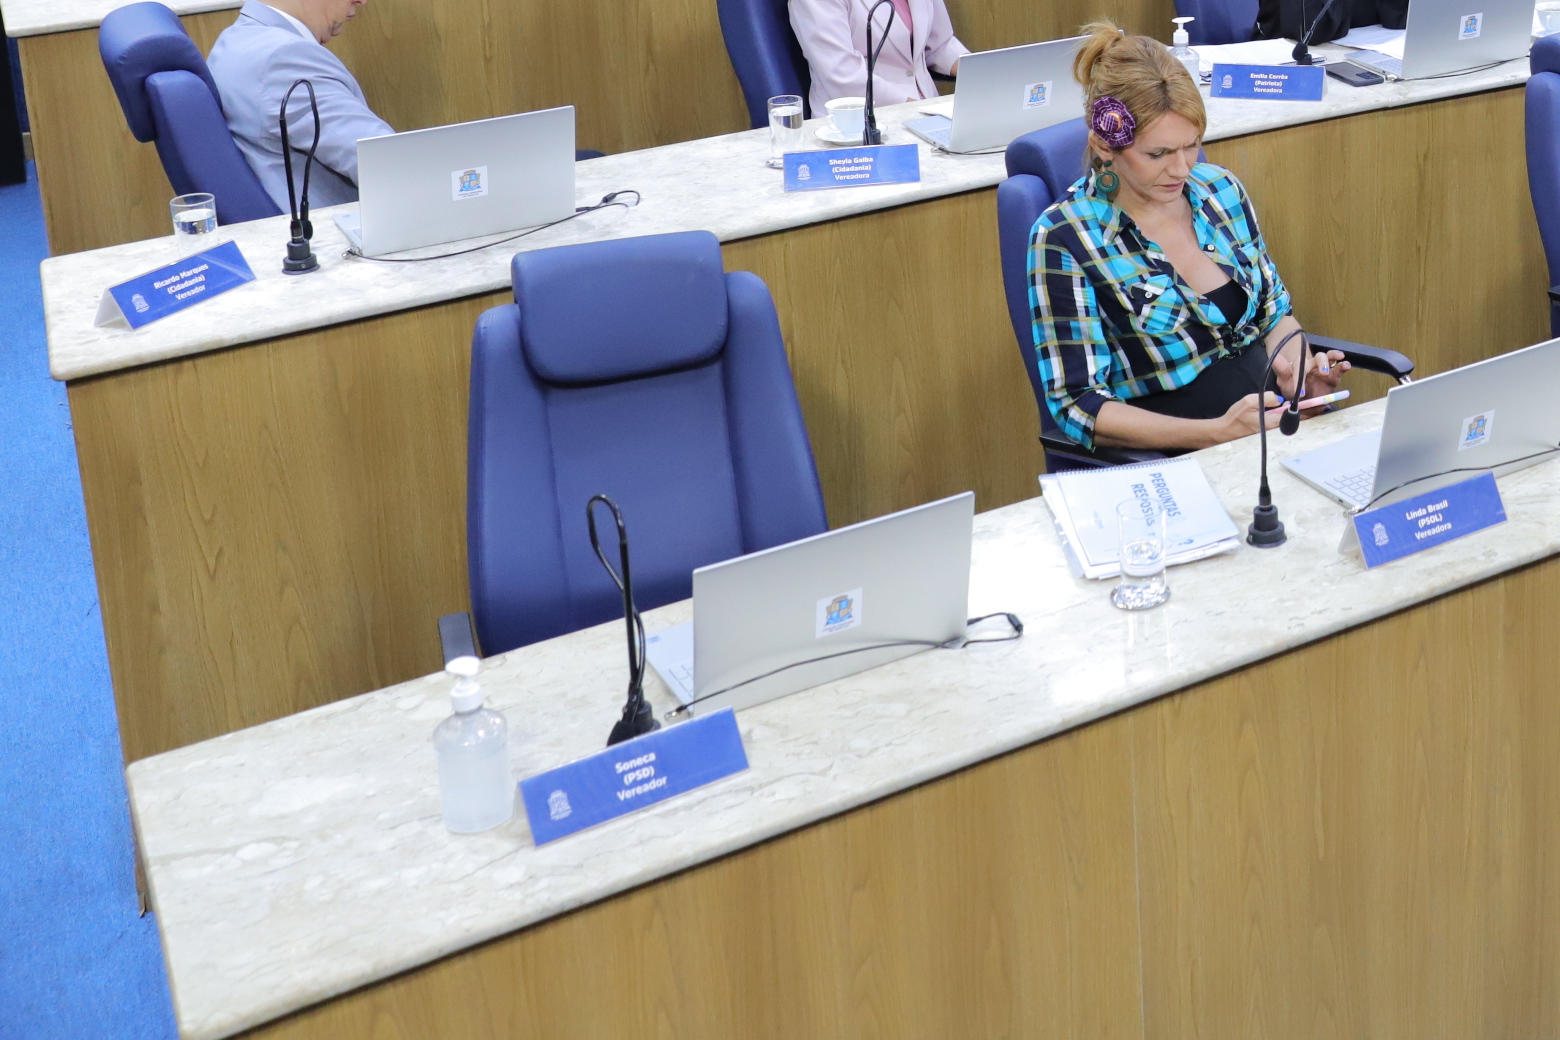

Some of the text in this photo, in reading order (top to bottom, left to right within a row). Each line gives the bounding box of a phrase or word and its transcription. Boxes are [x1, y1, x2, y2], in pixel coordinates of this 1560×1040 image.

[1254, 80, 1282, 88] (Patriota)
[828, 156, 874, 166] Sheyla Galba
[832, 164, 872, 174] (Cidadania)
[834, 173, 870, 181] Vereadora
[153, 263, 209, 290] Ricardo Marques
[167, 274, 206, 295] (Cidadania)
[175, 284, 206, 301] Vereador
[1149, 472, 1181, 517] PERGUNTAS
[1405, 499, 1449, 521] Linda Brasil
[1418, 513, 1443, 529] (PSOL)
[1414, 522, 1452, 541] Vereadora
[615, 752, 656, 774] Soneca
[623, 766, 655, 786] (PSD)
[616, 775, 668, 801] Vereador
